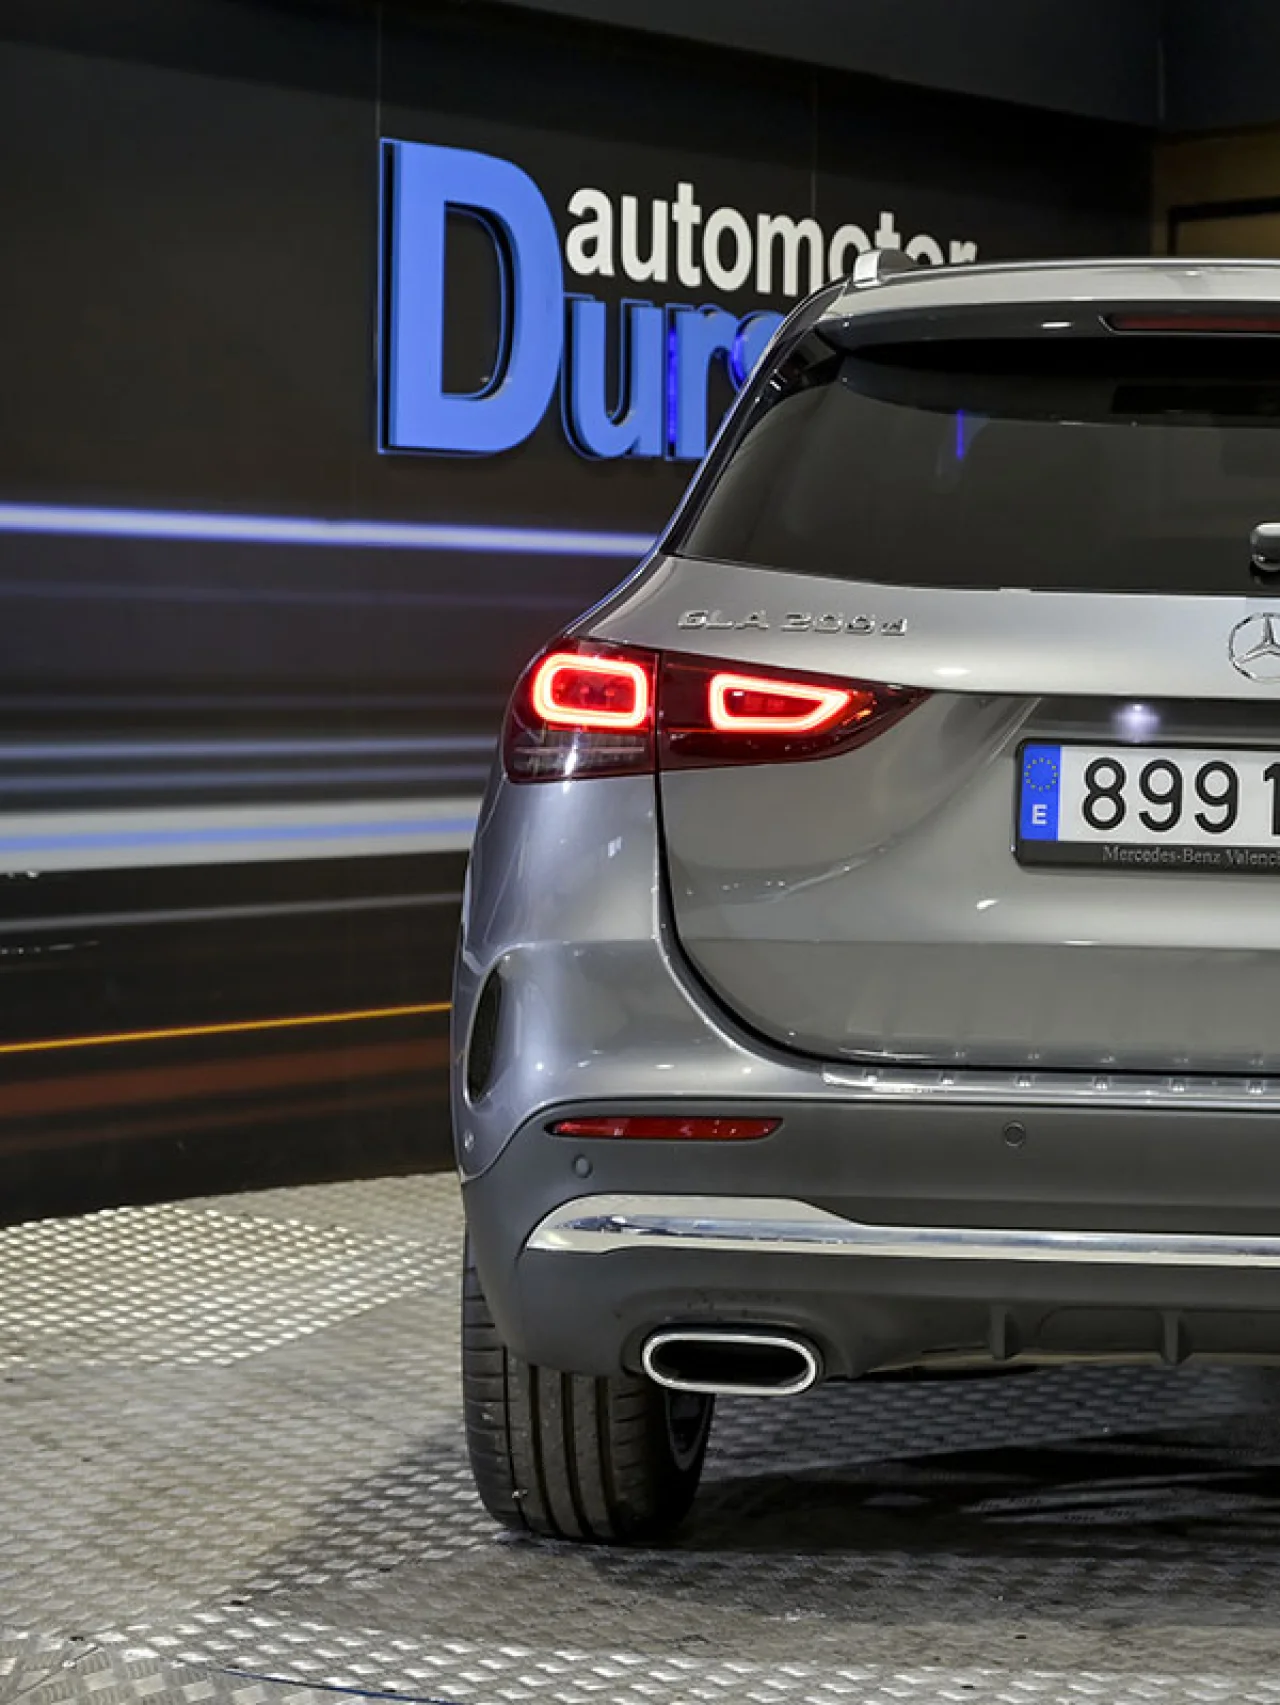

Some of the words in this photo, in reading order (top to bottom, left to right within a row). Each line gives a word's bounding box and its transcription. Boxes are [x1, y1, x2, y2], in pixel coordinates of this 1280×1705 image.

[378, 137, 785, 461] Dur
[677, 609, 770, 630] GLA
[1031, 804, 1048, 825] E
[1102, 845, 1221, 864] Mercedes-Benz
